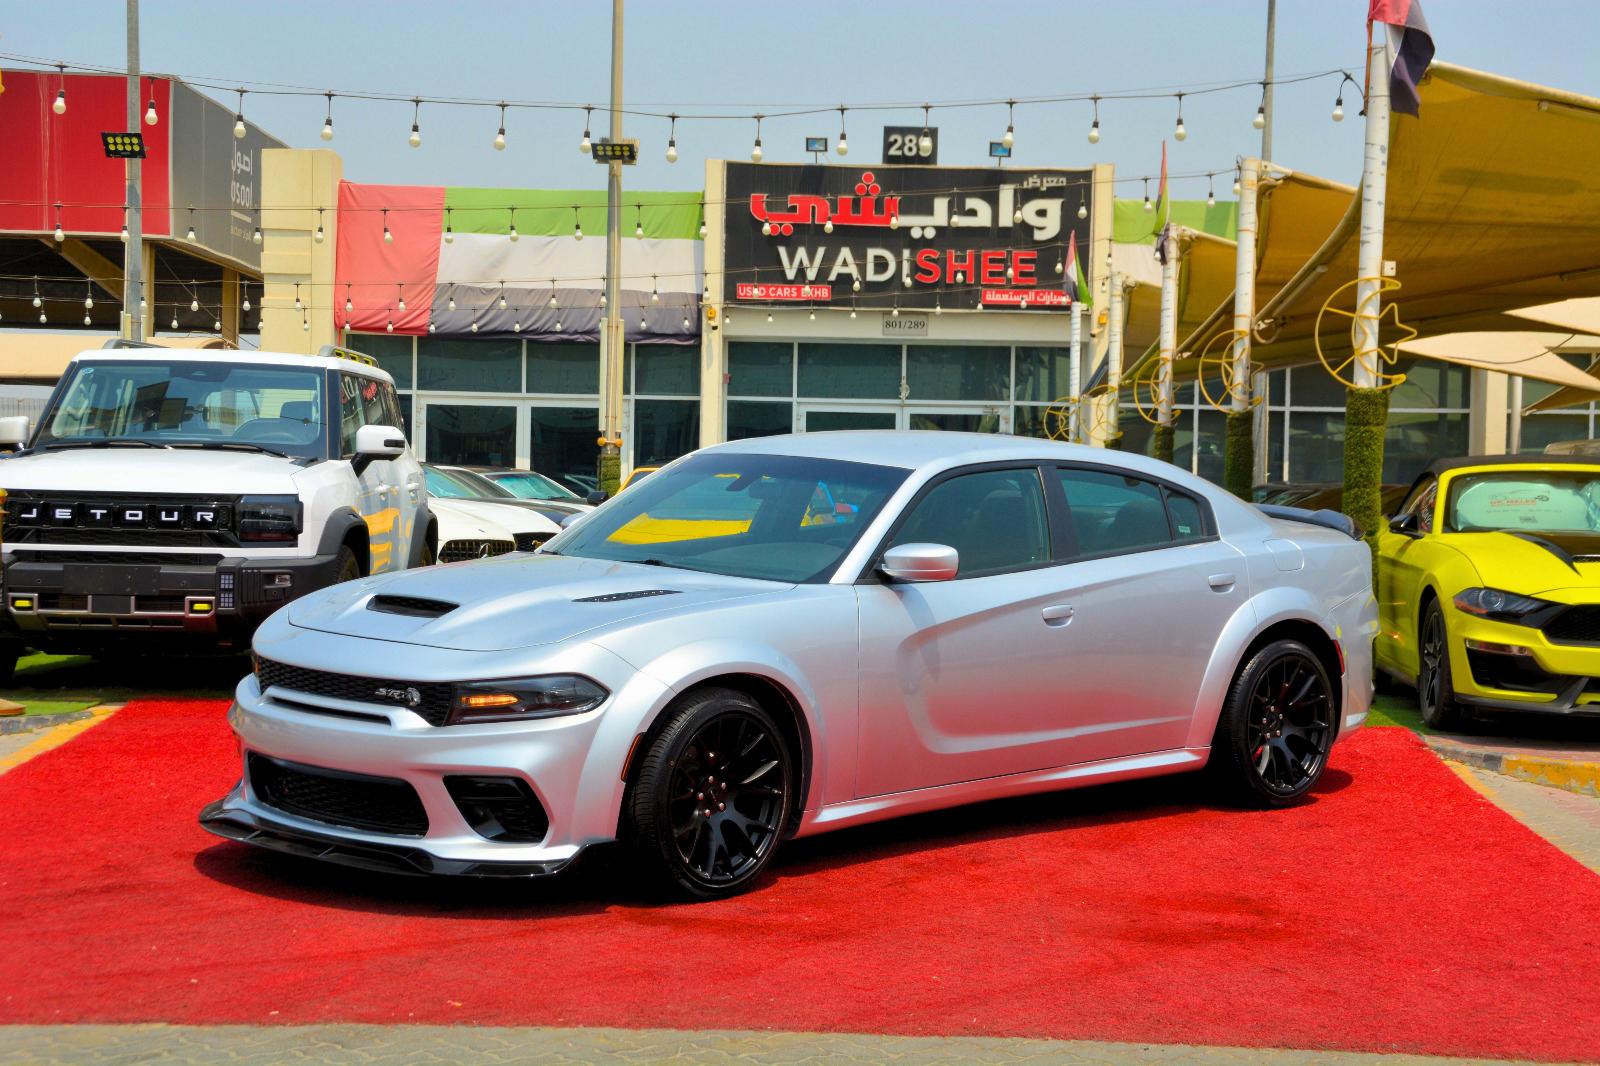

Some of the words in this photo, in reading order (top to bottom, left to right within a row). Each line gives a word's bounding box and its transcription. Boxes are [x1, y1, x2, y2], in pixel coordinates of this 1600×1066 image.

[1023, 175, 1067, 191] معرض
[738, 286, 766, 296] USD
[768, 287, 797, 297] CARS
[801, 288, 829, 298] EXHB
[885, 320, 926, 329] 801/289
[20, 509, 214, 521] JETOUR
